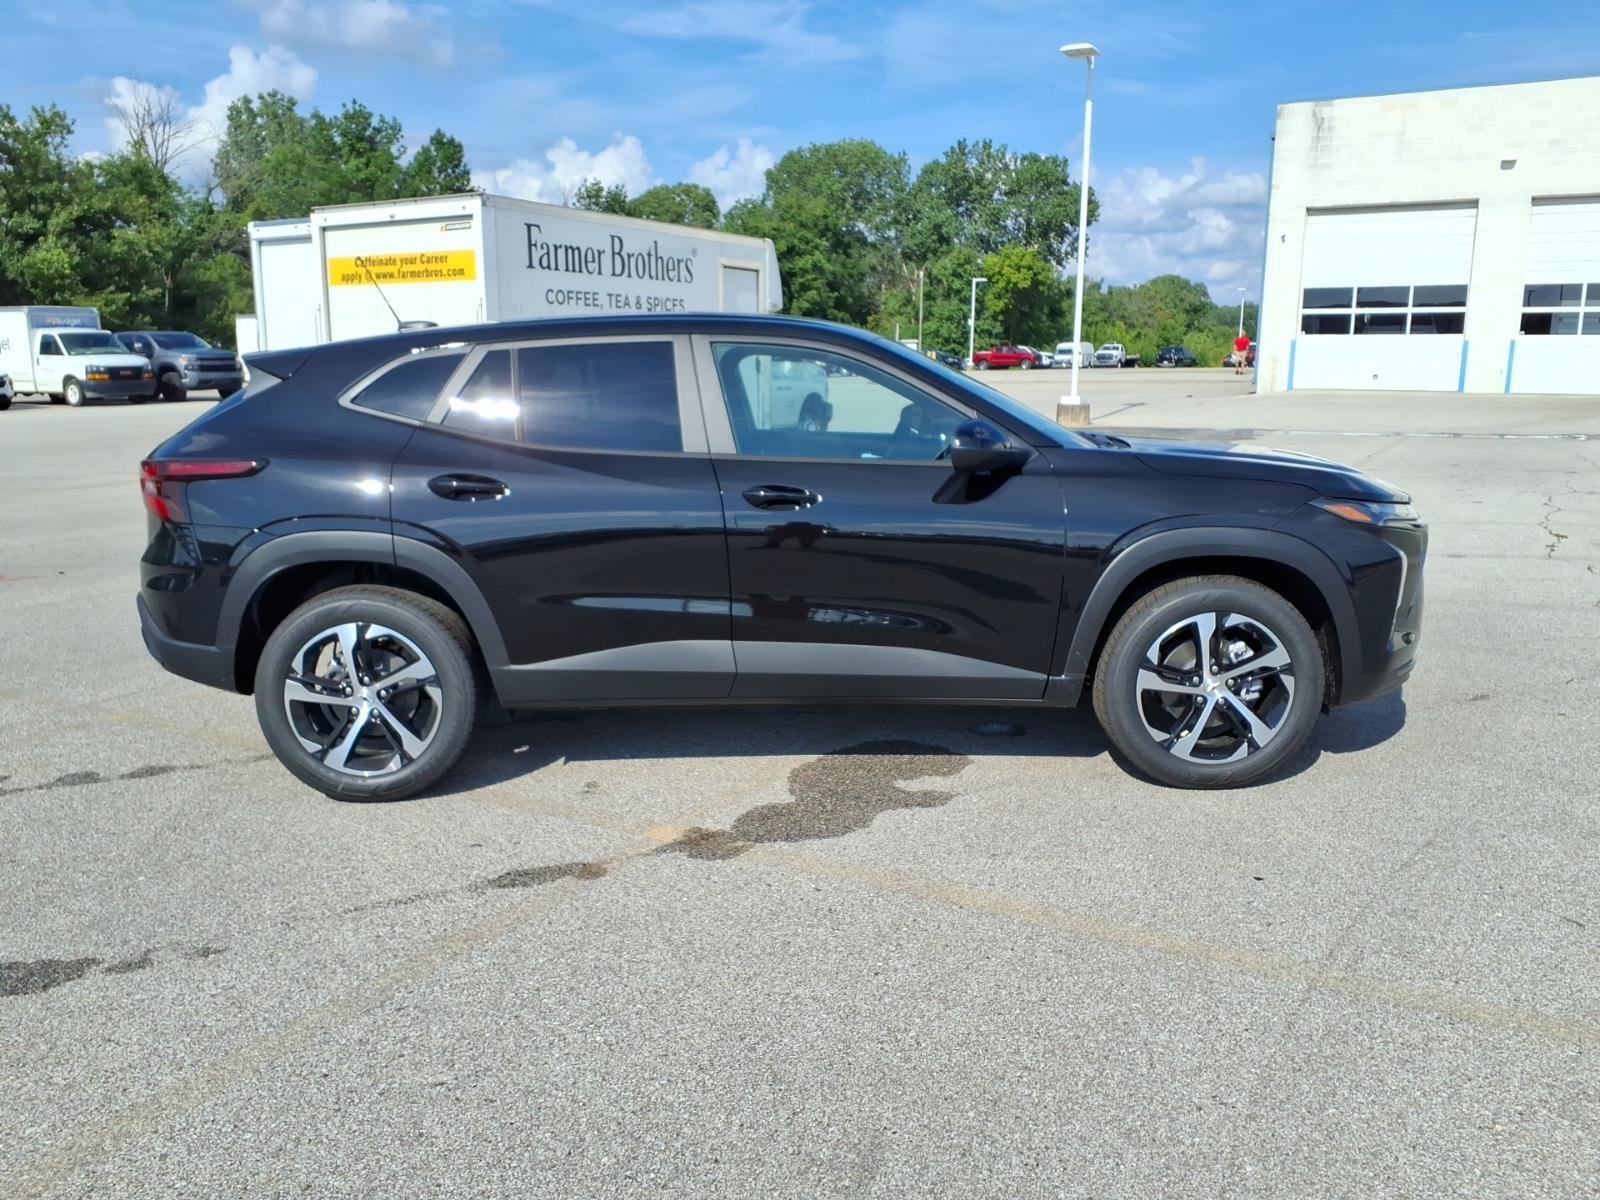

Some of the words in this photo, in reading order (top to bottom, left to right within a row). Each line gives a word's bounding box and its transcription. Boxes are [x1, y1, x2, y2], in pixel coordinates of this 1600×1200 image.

[354, 255, 397, 268] Caffeinate
[399, 256, 418, 267] your
[420, 253, 448, 265] Career
[524, 223, 606, 276] Farmer
[609, 234, 694, 284] Brothers
[341, 271, 362, 283] apply
[375, 267, 465, 280] www.farmerbros.com
[545, 288, 604, 311] COFFEE,
[607, 293, 632, 310] TEA
[635, 295, 644, 311] &
[646, 296, 686, 312] SPICES
